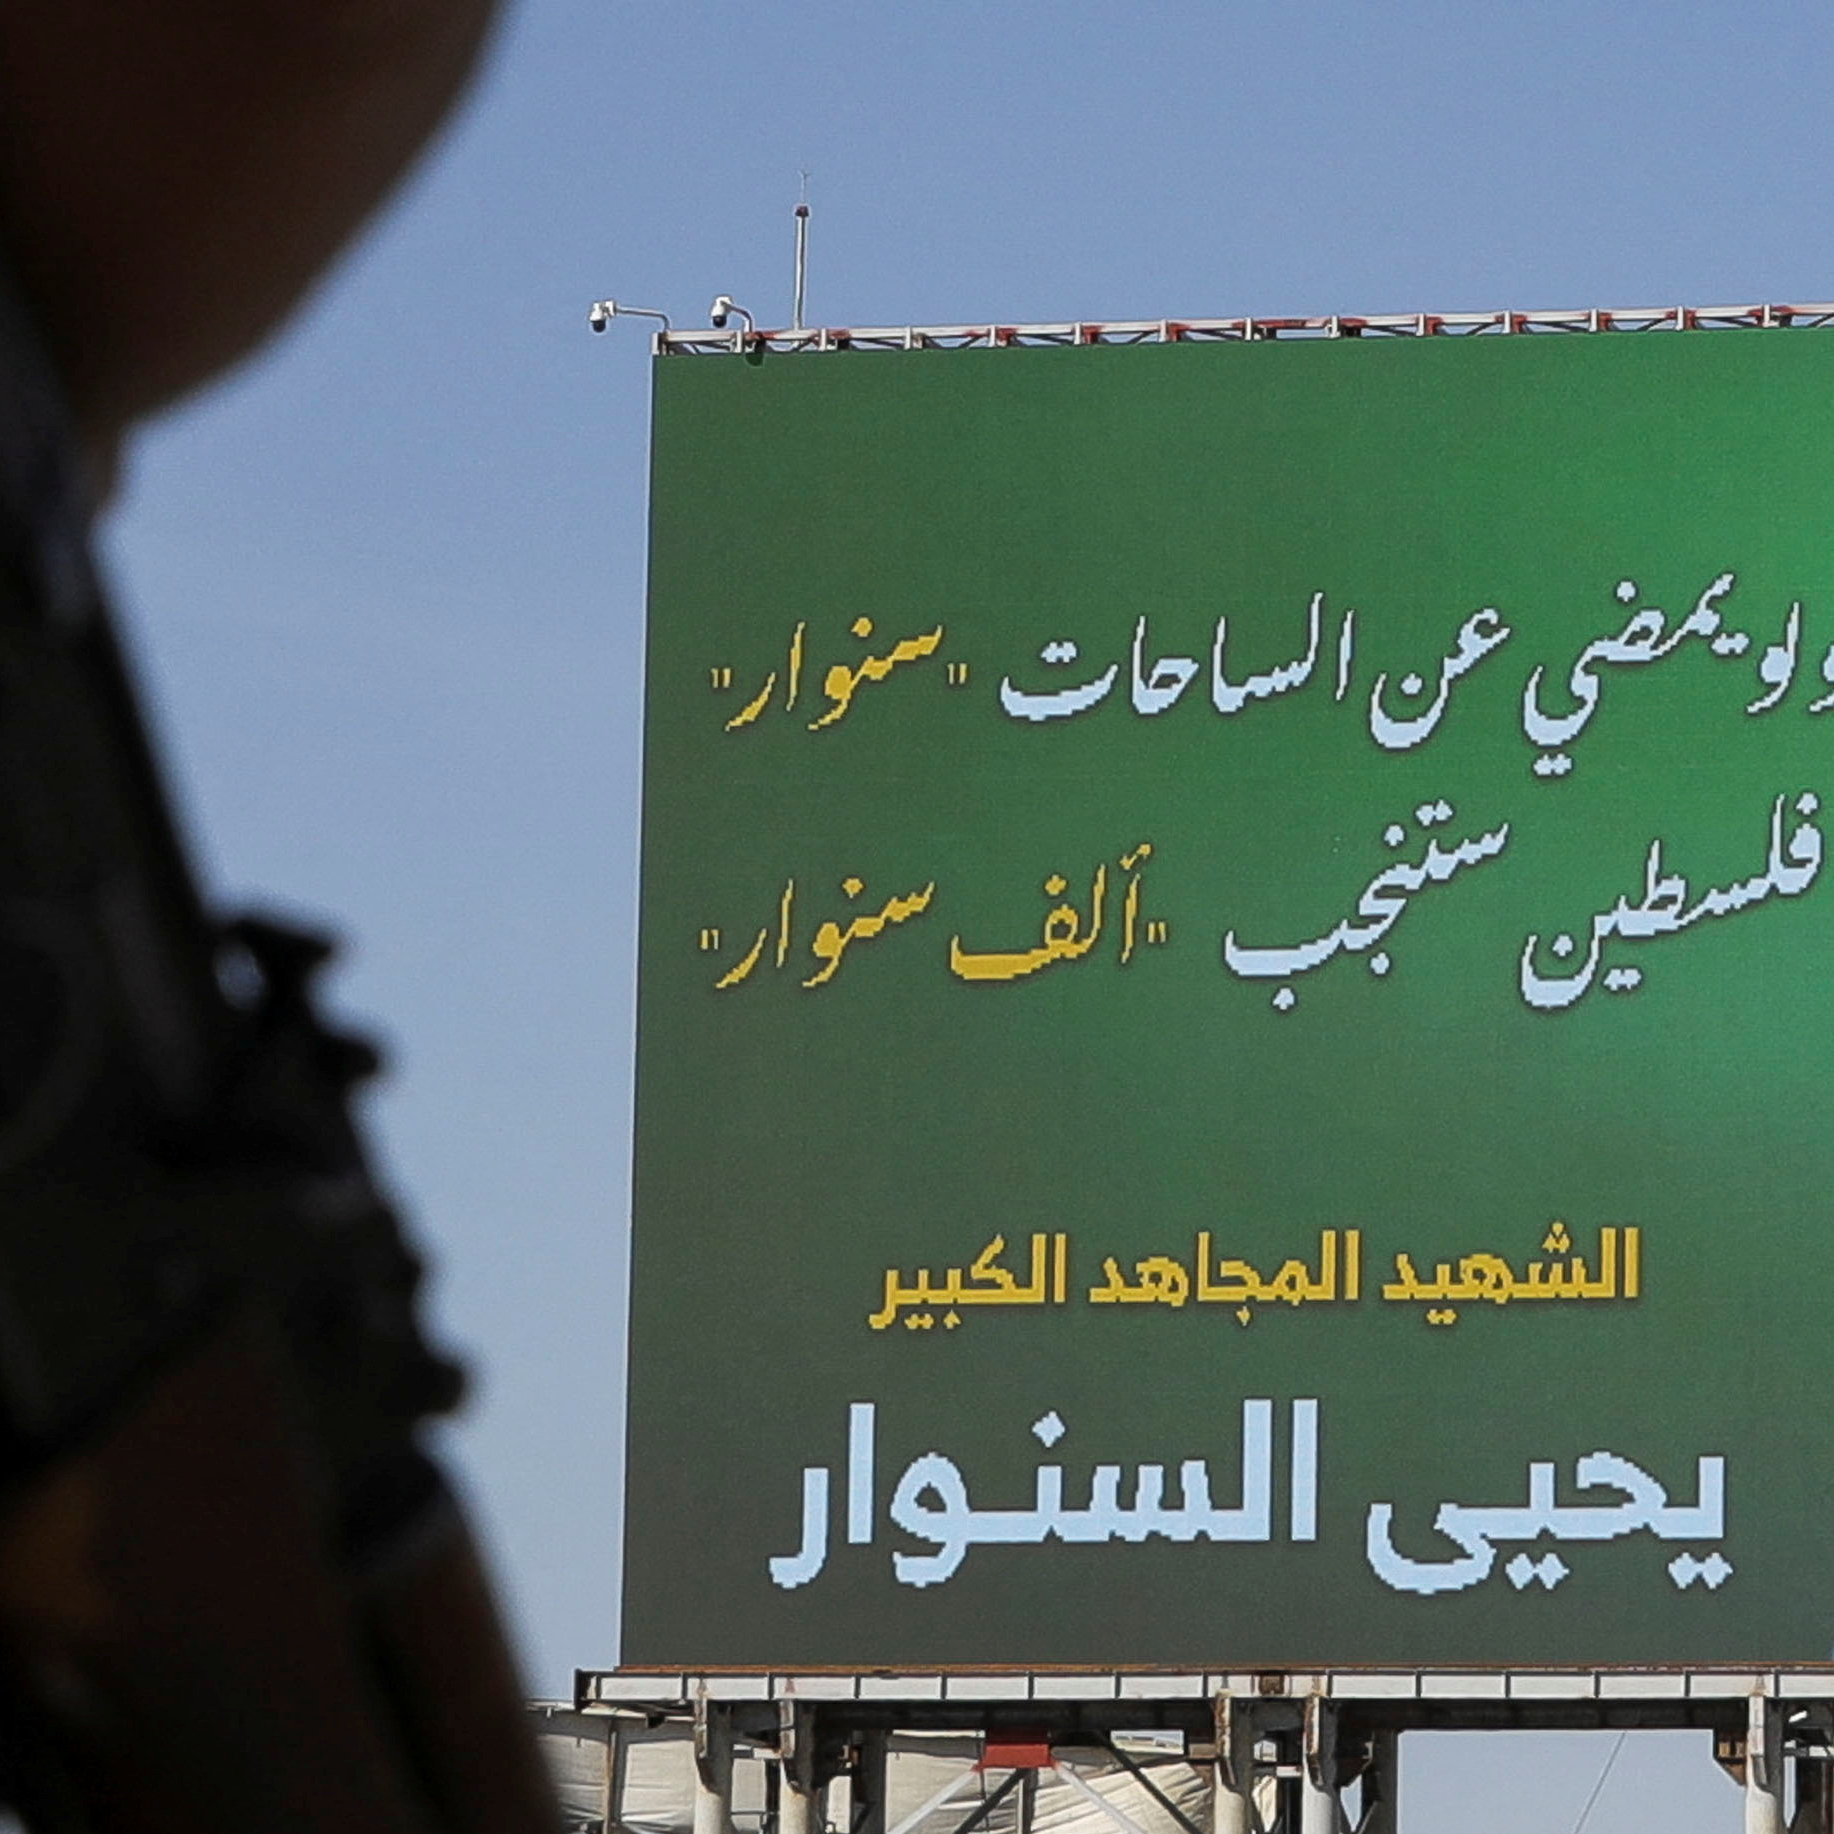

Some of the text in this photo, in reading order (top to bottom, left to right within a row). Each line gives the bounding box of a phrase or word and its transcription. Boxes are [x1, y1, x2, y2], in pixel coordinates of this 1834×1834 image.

[710, 616, 968, 733] "سنوار"
[999, 591, 1355, 722] الساحات
[1369, 607, 1512, 749] عن
[1523, 573, 1750, 776] يمضي
[700, 792, 1822, 1011] فلسطين ستنجب "ألف سنوار"
[867, 1221, 1640, 1331] الشهيد المجاهد الكبير
[768, 1397, 1734, 1596] يحيى السنوار
